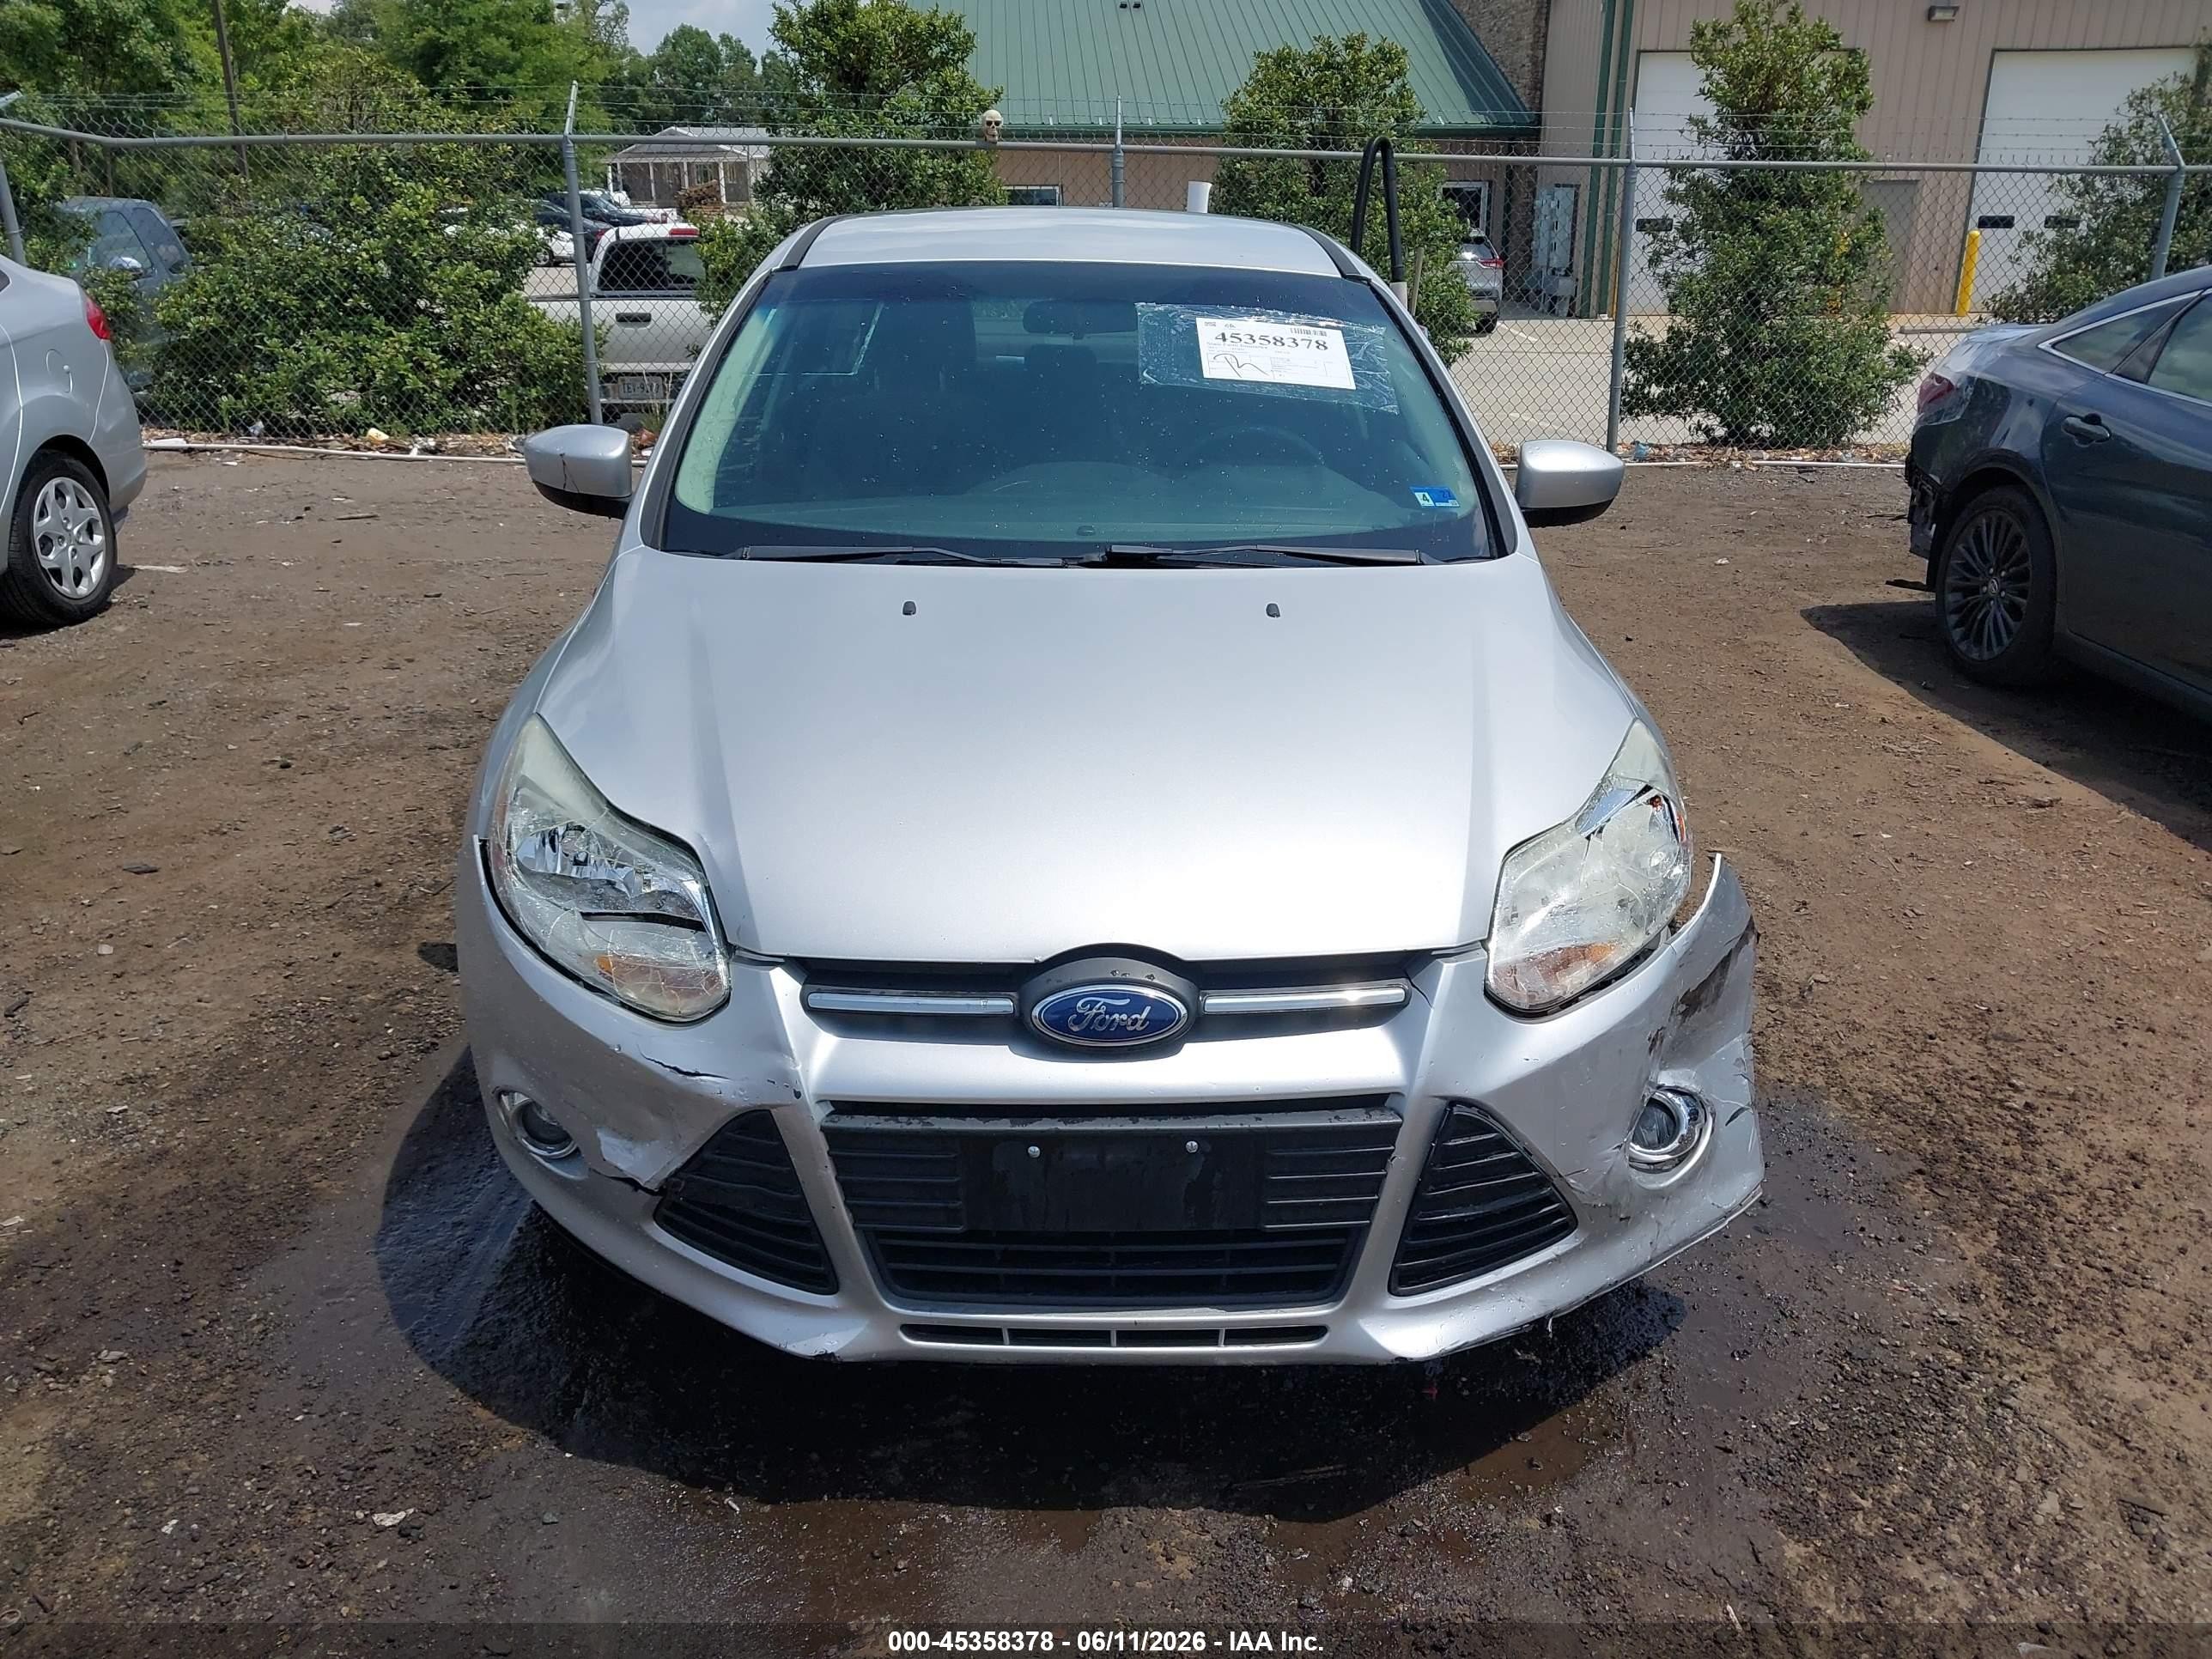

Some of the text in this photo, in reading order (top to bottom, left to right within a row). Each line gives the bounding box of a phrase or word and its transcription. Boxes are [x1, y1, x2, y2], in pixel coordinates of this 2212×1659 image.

[1215, 331, 1328, 350] 45358378
[1422, 493, 1430, 502] 4
[1067, 996, 1152, 1032] Ford
